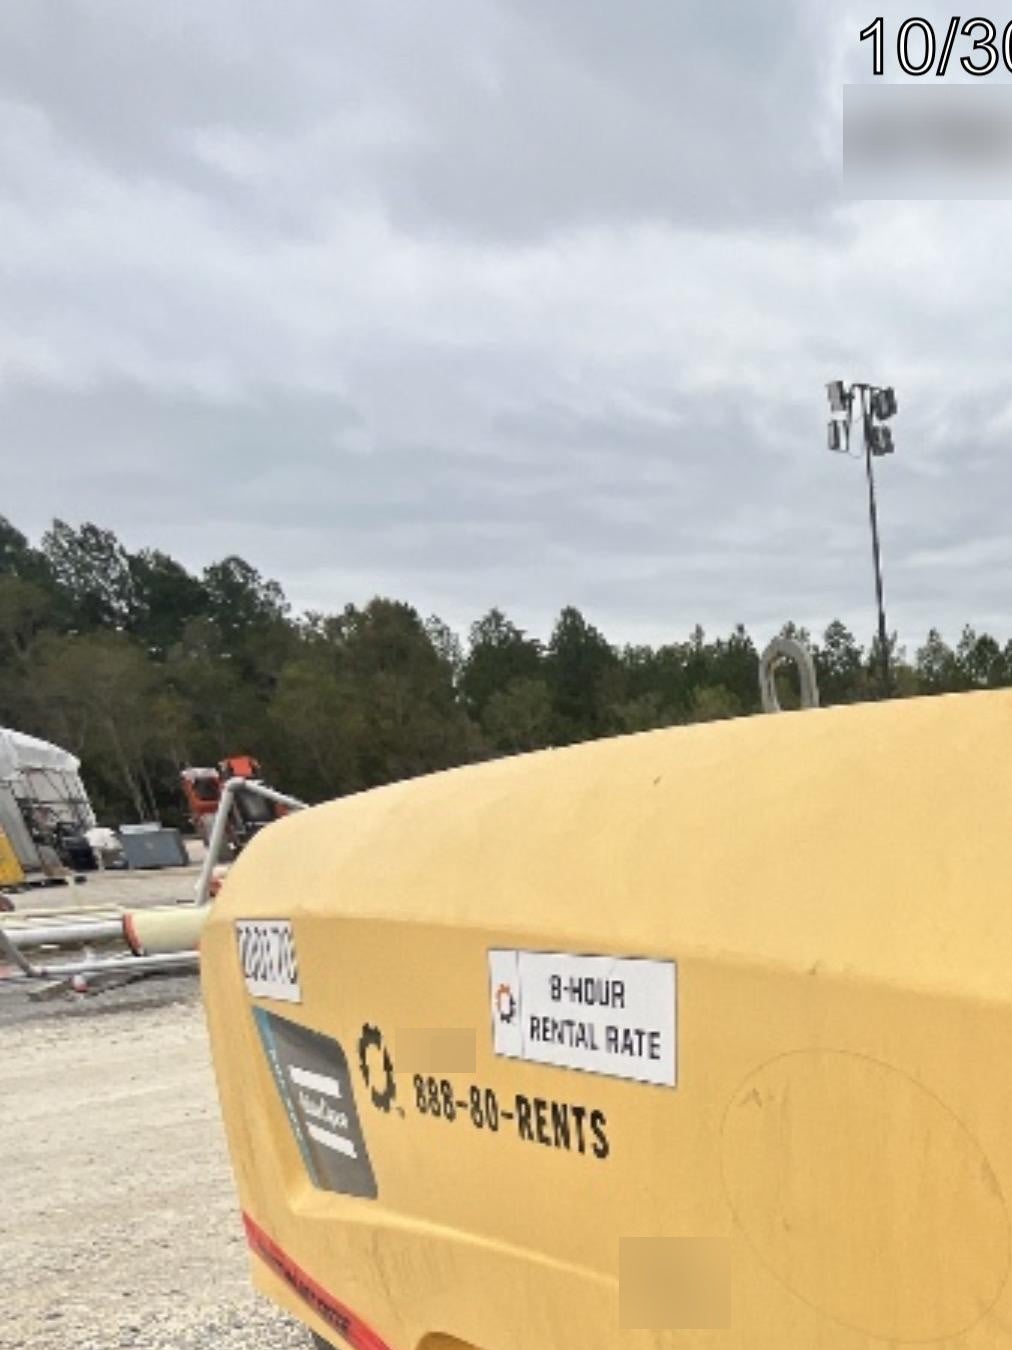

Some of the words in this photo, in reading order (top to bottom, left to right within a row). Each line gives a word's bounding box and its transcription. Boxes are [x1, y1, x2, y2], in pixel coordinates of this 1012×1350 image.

[550, 974, 626, 1009] 8-HOUR
[529, 1015, 599, 1051] RENTAL
[605, 1025, 662, 1060] RATE
[412, 1073, 610, 1159] 888-80-RENTS
